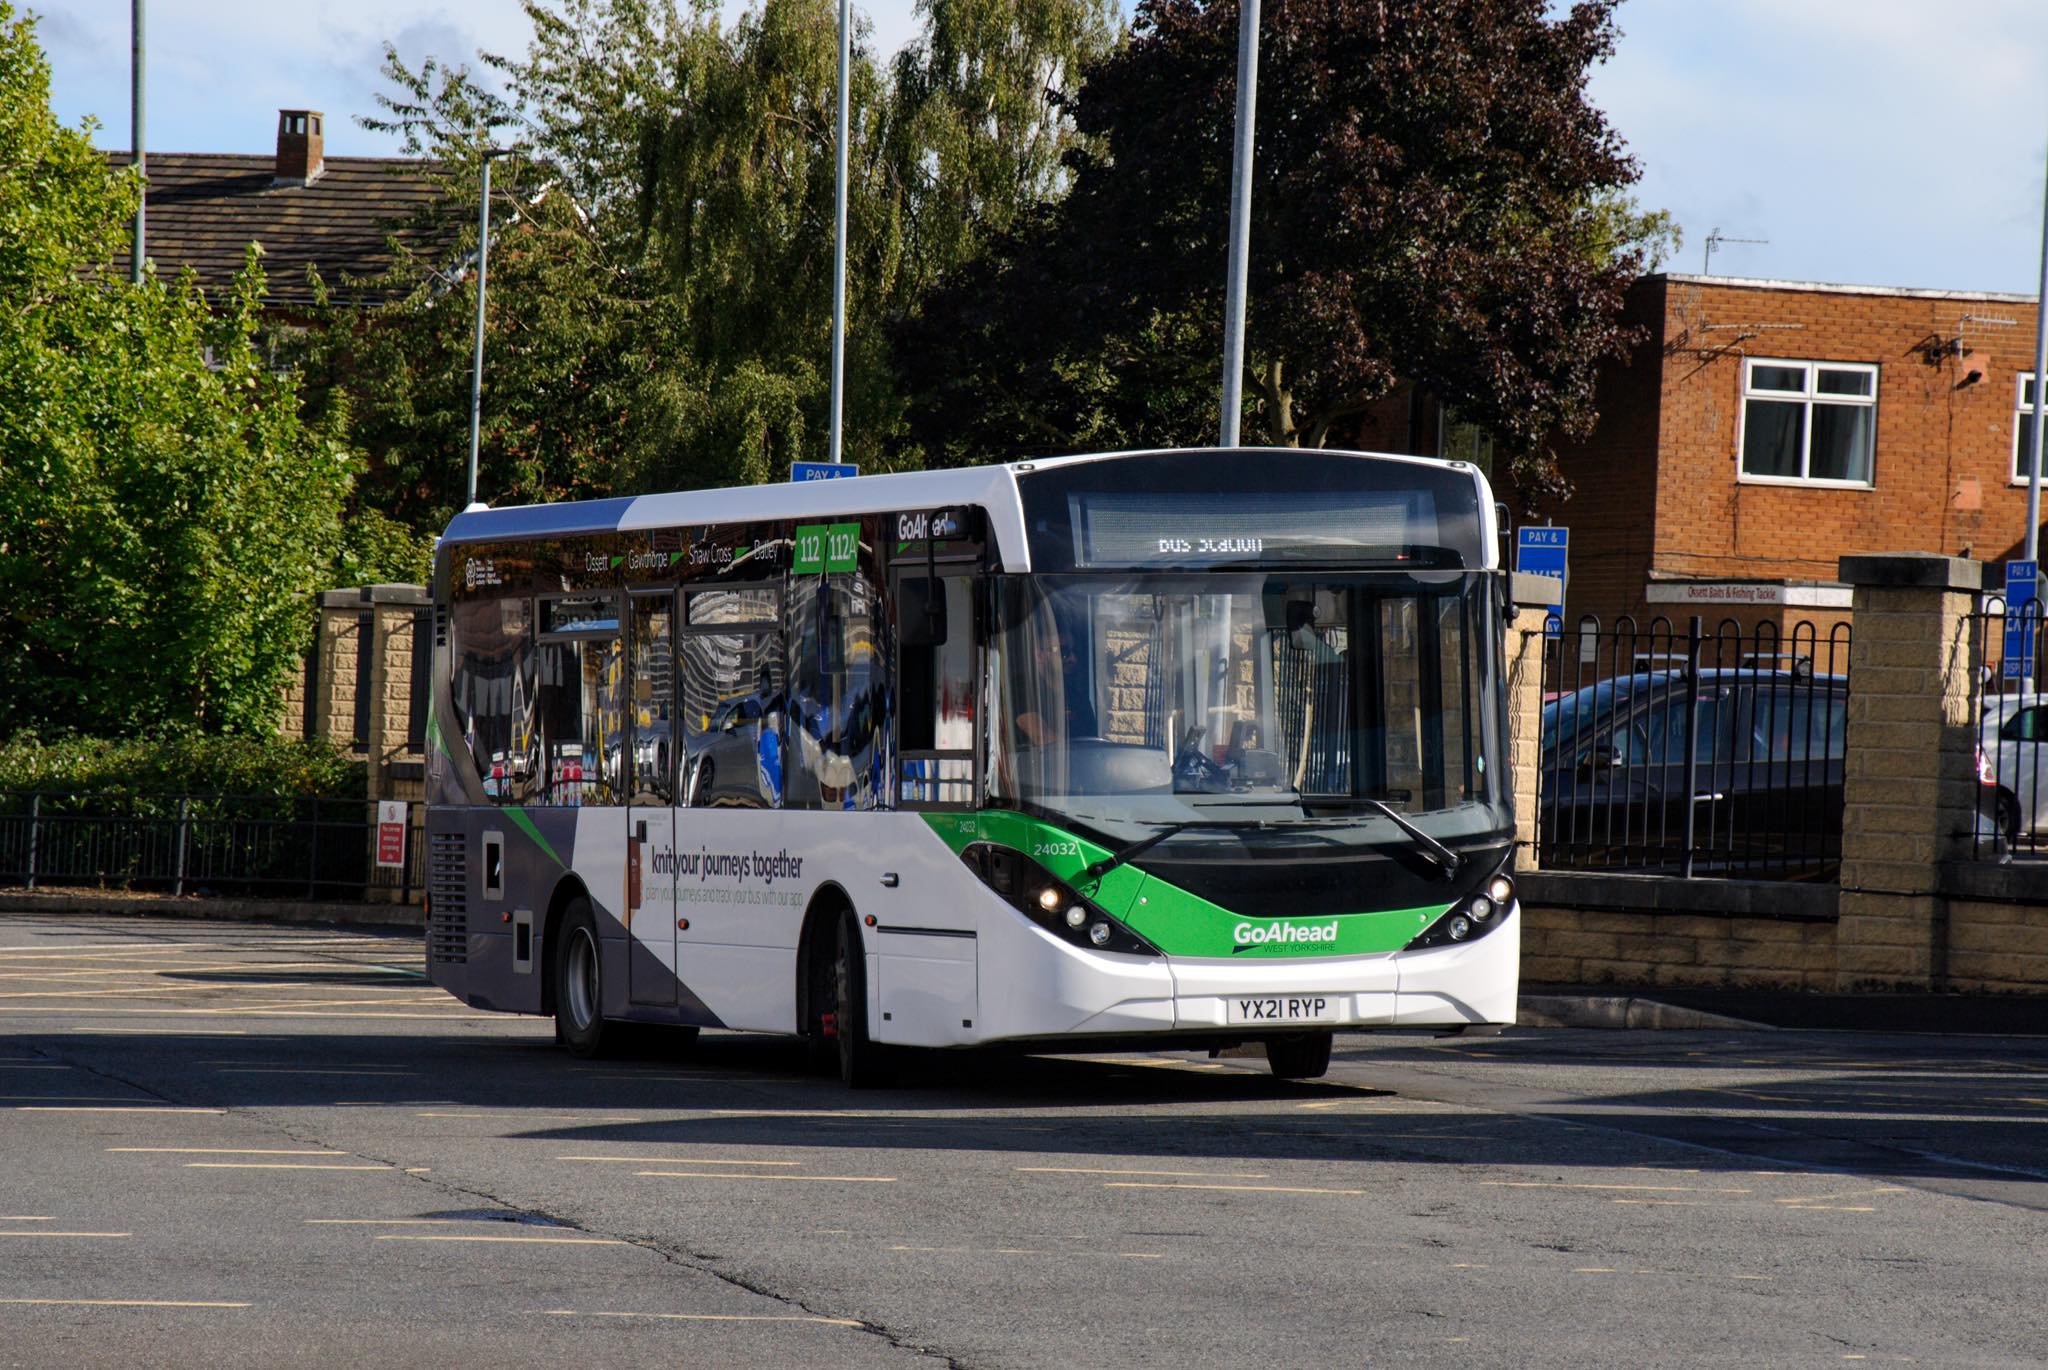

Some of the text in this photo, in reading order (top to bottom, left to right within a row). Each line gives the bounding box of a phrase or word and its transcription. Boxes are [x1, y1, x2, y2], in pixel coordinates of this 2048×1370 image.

[806, 468, 841, 481] PAY &
[1528, 531, 1558, 543] PAY &
[801, 535, 820, 562] 112
[830, 533, 857, 561] 112A
[586, 552, 608, 572] Ossett
[689, 543, 709, 566] Shaw
[711, 543, 732, 564] Cross
[754, 539, 778, 563] Batley
[2012, 565, 2025, 577] PAY
[1725, 586, 1732, 598] &
[1756, 587, 1776, 600] Tackle
[960, 821, 975, 833] 24032
[1034, 843, 1076, 856] 24032
[652, 845, 673, 874] knit
[674, 852, 700, 881] your
[701, 846, 750, 883] journeys
[752, 849, 803, 884] together
[1234, 921, 1338, 944] GoAhead
[1263, 943, 1336, 953] WEST YORKSHIRE
[1240, 999, 1326, 1019] YX21 RYP
